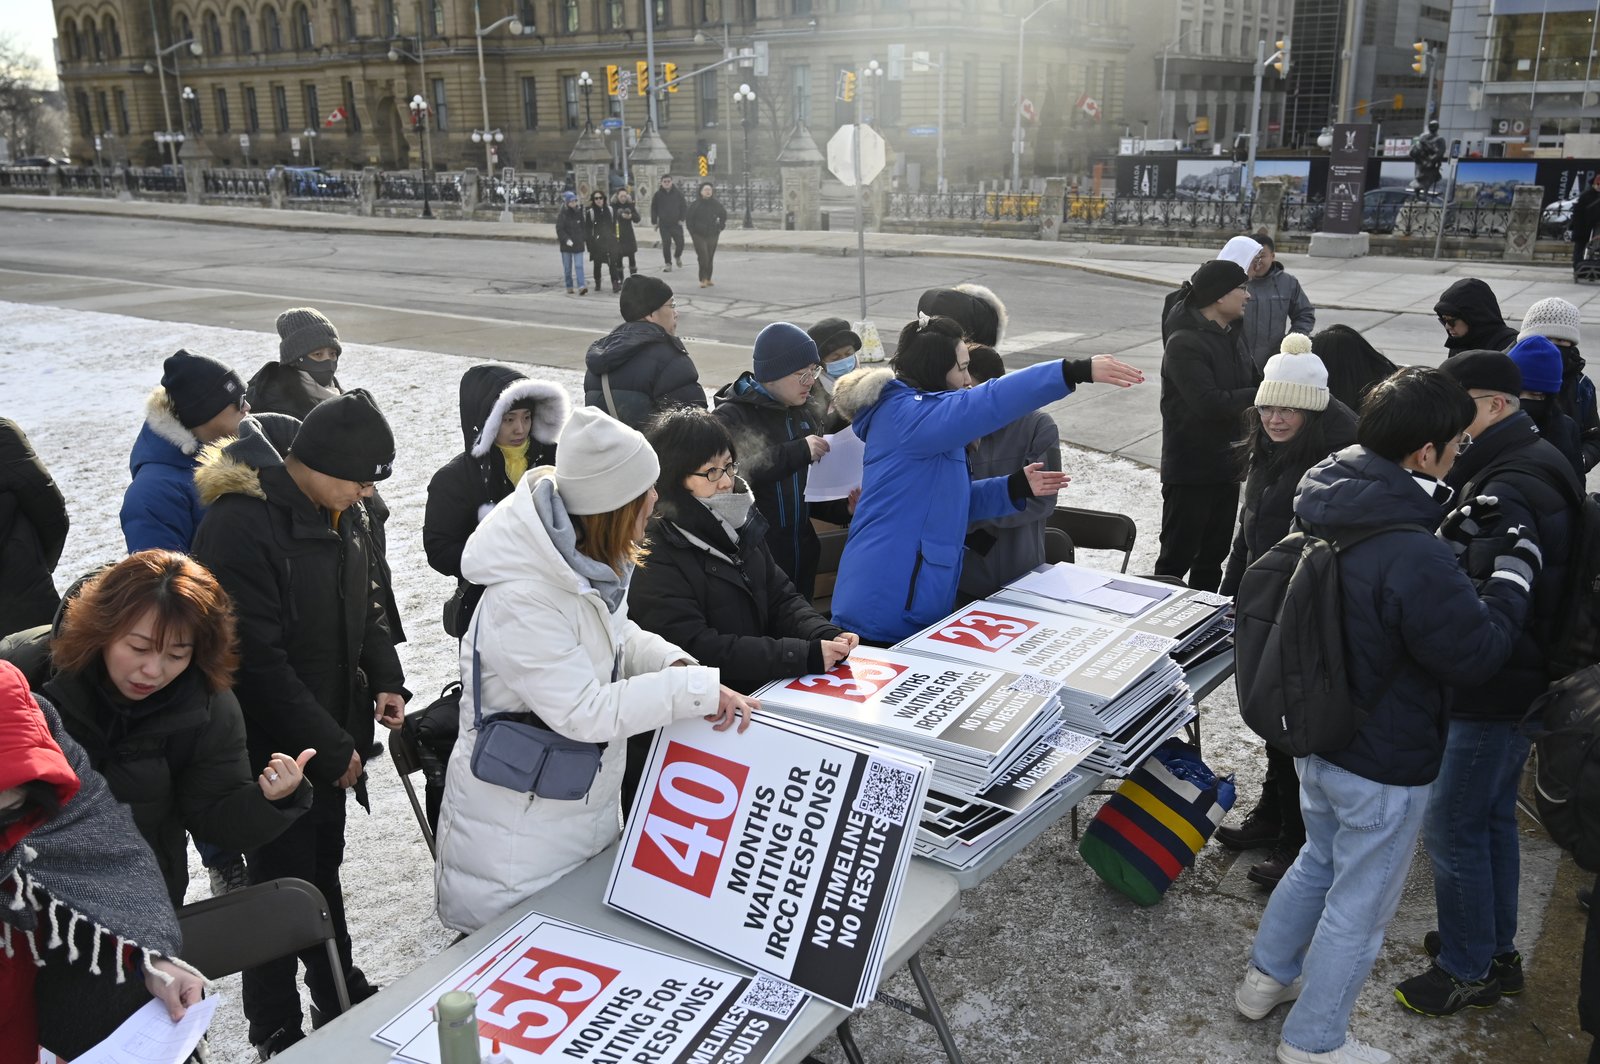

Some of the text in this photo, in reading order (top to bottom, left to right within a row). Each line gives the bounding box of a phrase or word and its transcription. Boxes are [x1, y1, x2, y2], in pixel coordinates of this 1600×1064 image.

[1498, 120, 1525, 134] 90
[1132, 164, 1141, 196] CANADA
[1558, 170, 1569, 200] ANADA
[939, 614, 1029, 649] 23
[1011, 627, 1059, 656] MONTHS
[1022, 626, 1089, 667] WAITING FOR
[1039, 627, 1115, 677] IRCC RESPONSE
[880, 672, 931, 706] MONTHS
[1080, 667, 1101, 679] NO
[1101, 669, 1122, 681] NO
[893, 670, 964, 719] WAITING FOR
[913, 670, 992, 731] IRCC RESPONSE
[983, 691, 1035, 733] NO RESULTS
[959, 718, 982, 731] NO
[1012, 776, 1036, 790] NO
[644, 761, 739, 877] 40
[726, 785, 776, 895] MONTHS
[743, 766, 811, 930] WAITING FOR
[764, 758, 842, 960] IRCC RESPONSE
[837, 816, 890, 949] NO RESULTS
[811, 914, 836, 949] NO
[475, 956, 602, 1039] 55
[562, 986, 643, 1059] MONTHS
[592, 978, 688, 1064] ITING FOR
[632, 976, 725, 1064] RESPONSE
